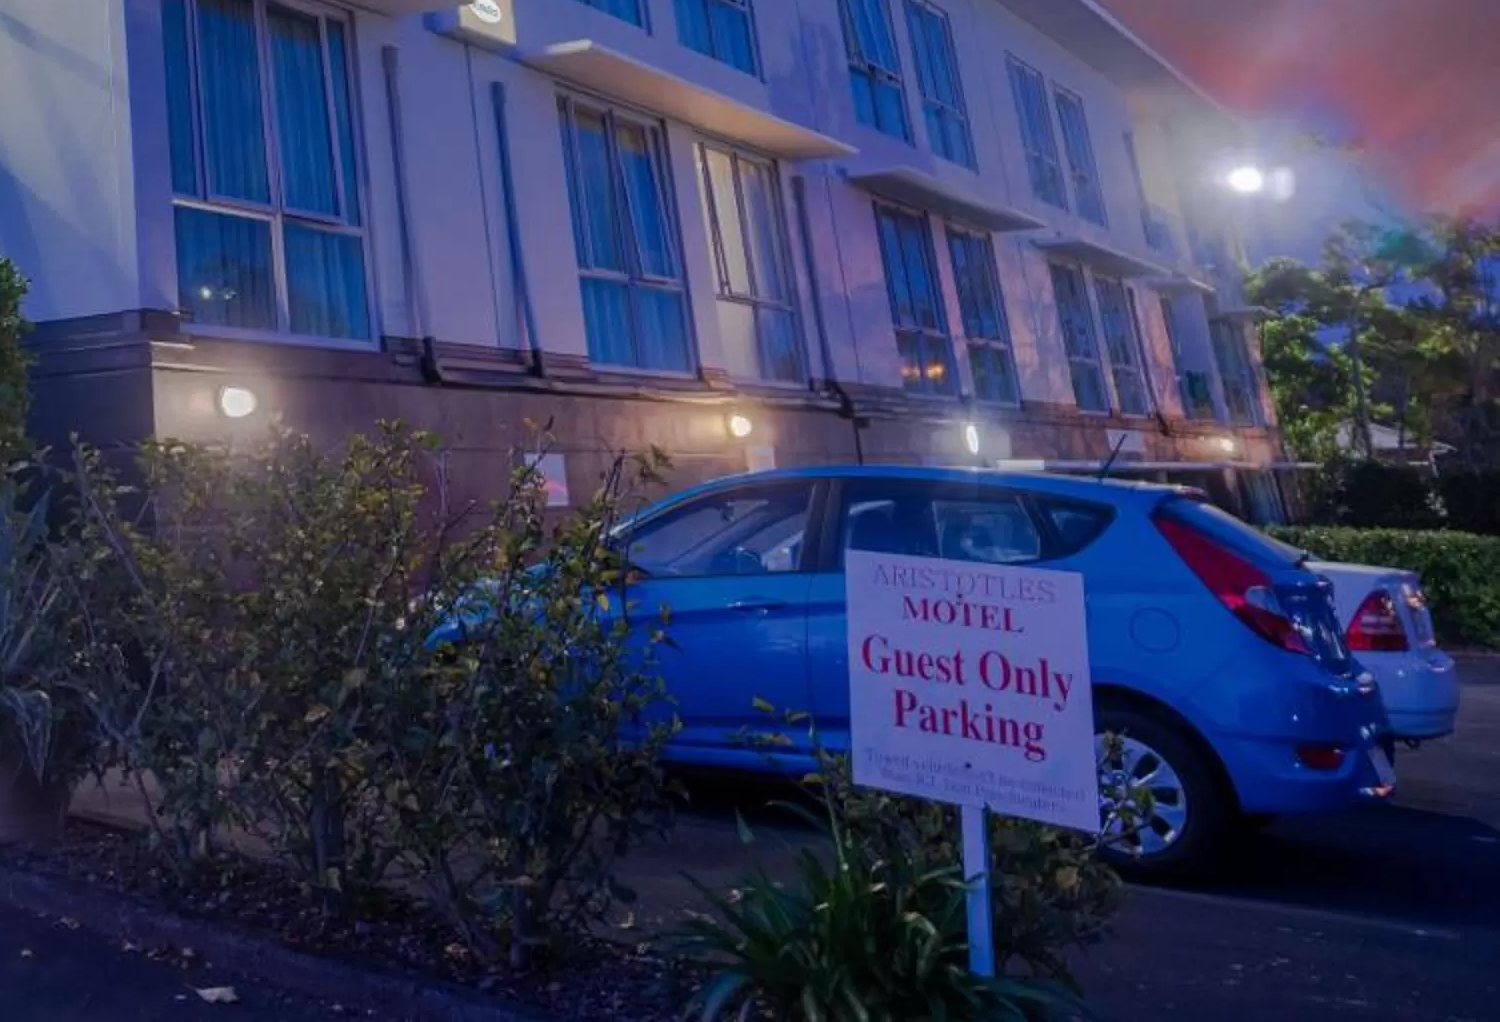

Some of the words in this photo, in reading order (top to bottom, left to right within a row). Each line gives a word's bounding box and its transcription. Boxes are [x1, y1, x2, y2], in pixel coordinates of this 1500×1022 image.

[871, 562, 1056, 604] ARISTOTLES
[902, 595, 1024, 633] MOTEL
[861, 633, 966, 686] Guest
[979, 650, 1073, 712] Only
[894, 688, 1047, 763] Parking
